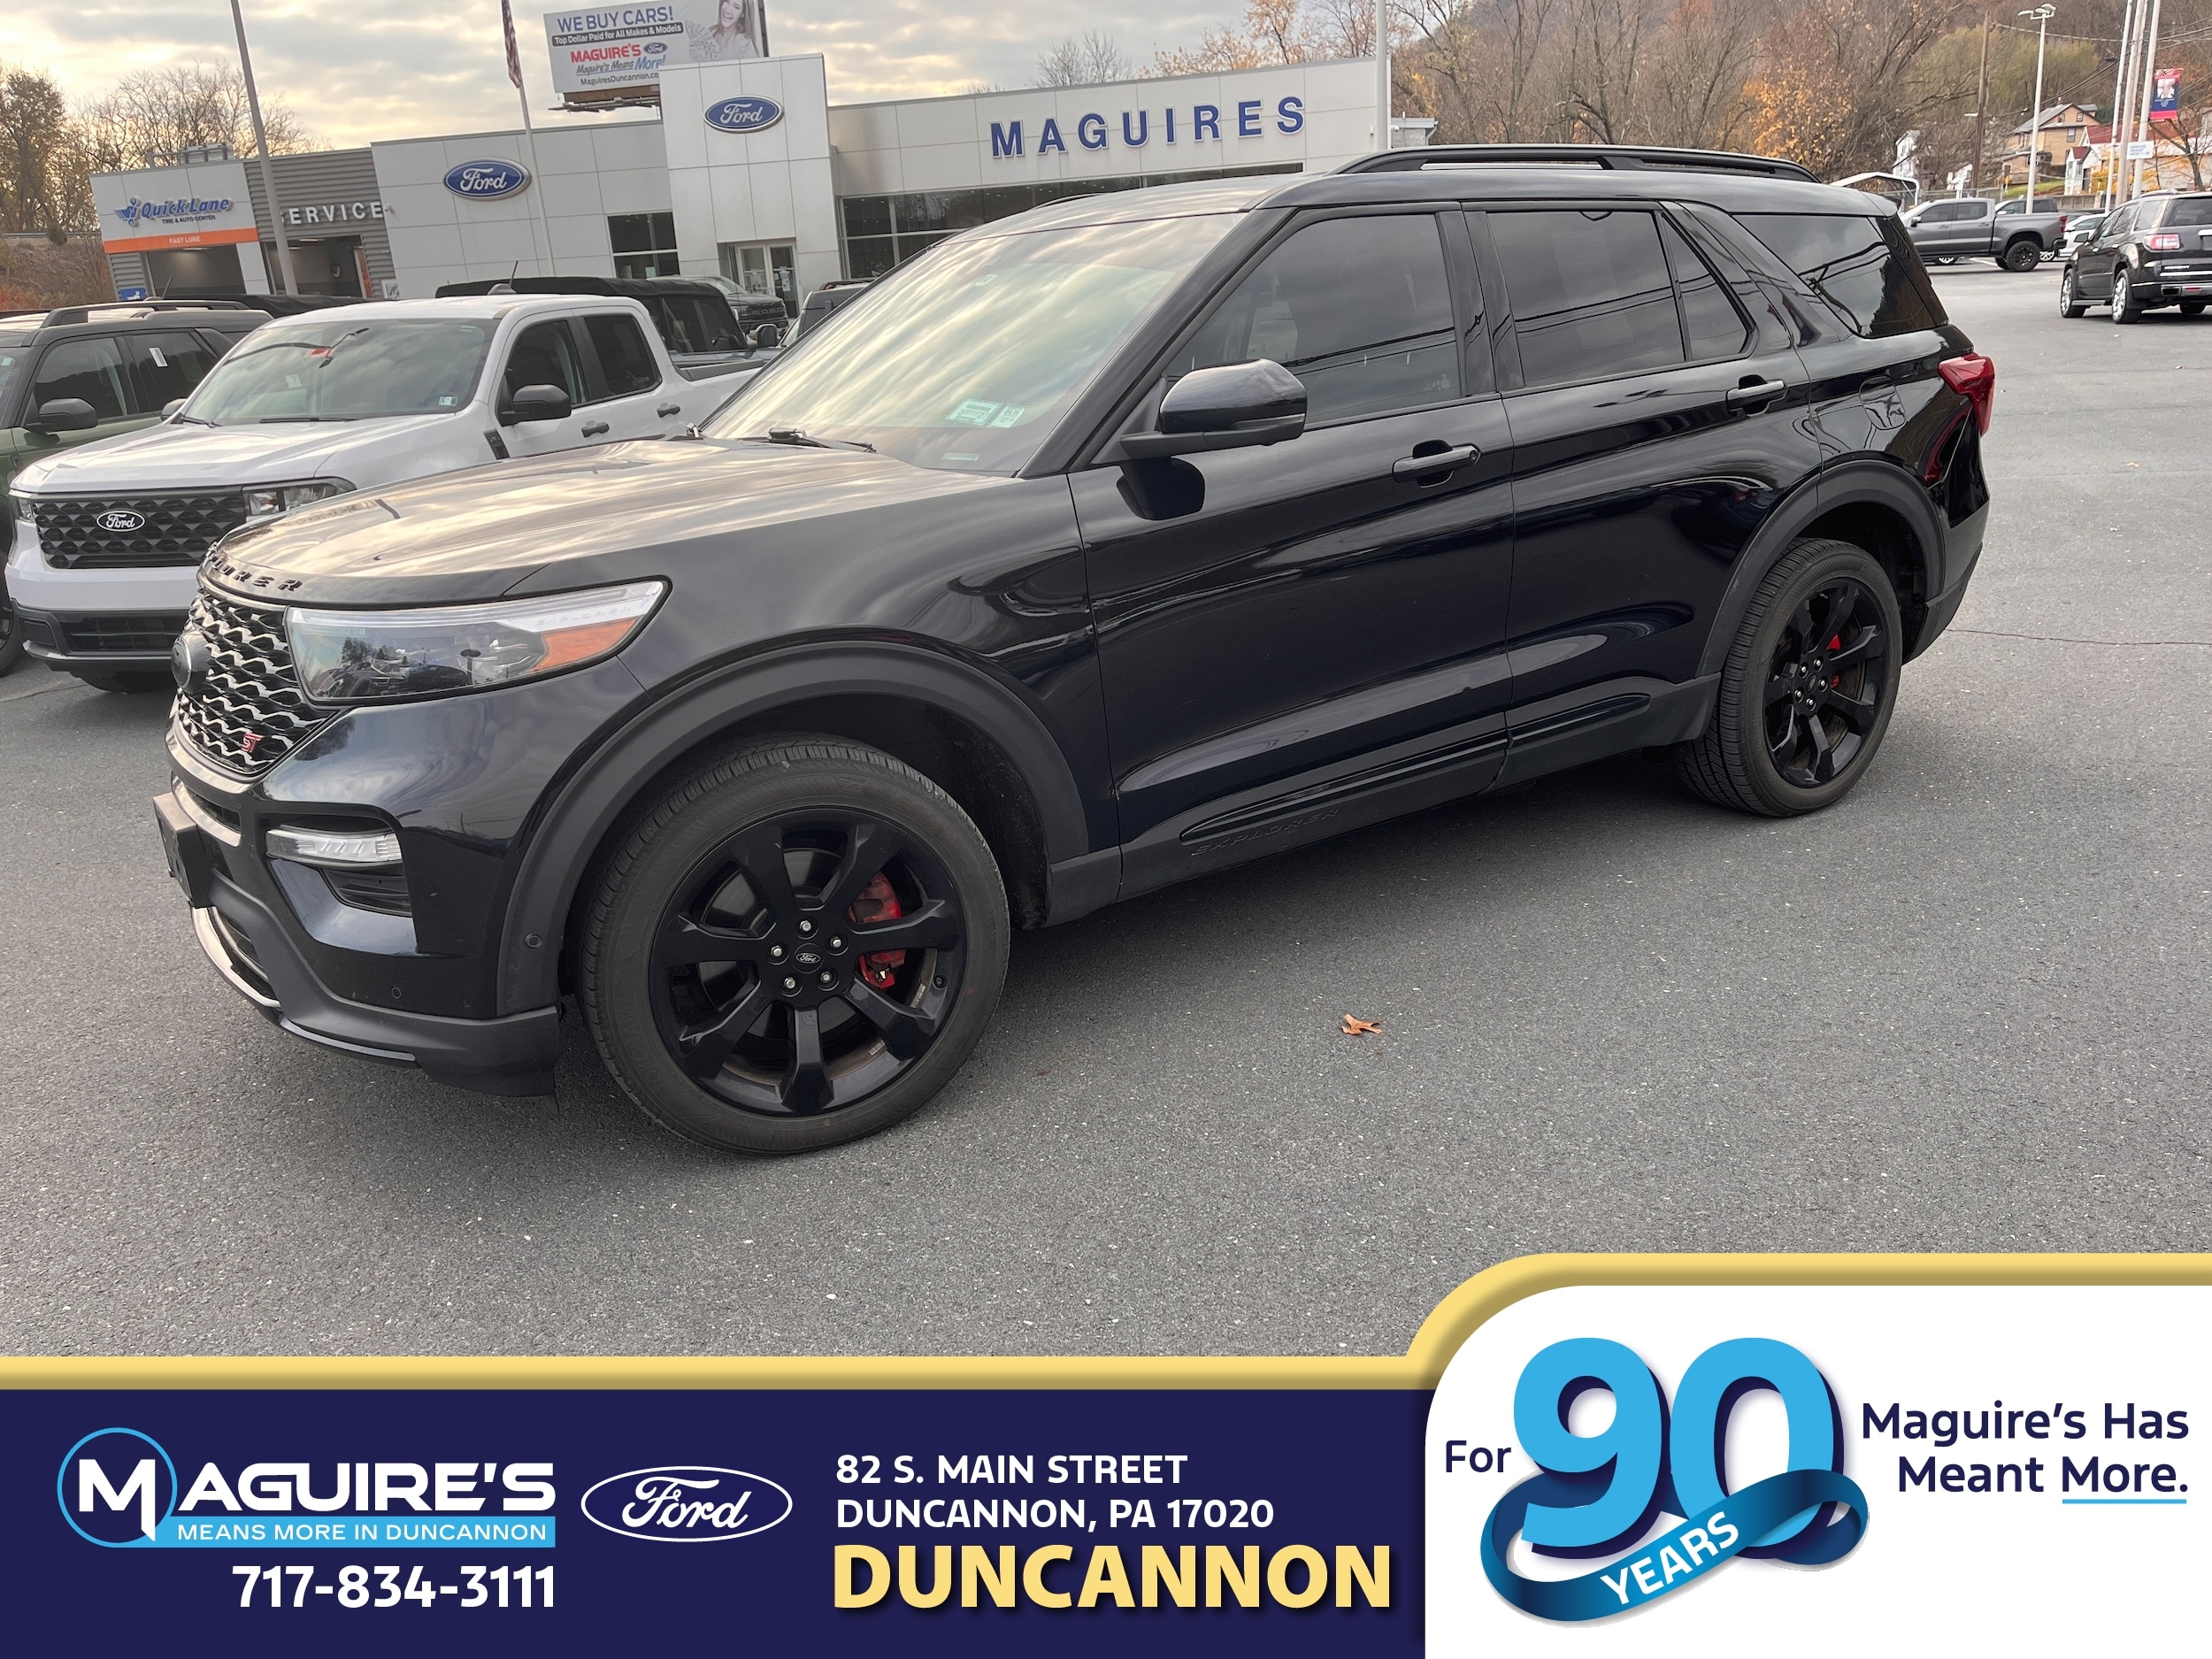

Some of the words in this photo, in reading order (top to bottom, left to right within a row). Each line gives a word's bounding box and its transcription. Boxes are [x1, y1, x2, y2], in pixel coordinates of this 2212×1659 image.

[557, 17, 583, 33] WE
[587, 12, 618, 30] BUY
[623, 6, 673, 25] CARS!
[554, 36, 567, 45] Top
[568, 33, 588, 42] Dollar
[589, 32, 603, 42] Paid
[604, 31, 615, 40] for
[626, 27, 649, 37] Makes
[656, 24, 681, 34] Models
[570, 43, 642, 63] MAGUIRE'S
[577, 63, 610, 75] Maguire's
[611, 60, 634, 70] Means
[634, 55, 666, 71] More!
[580, 72, 659, 86] MaguiresDuncannon.co
[719, 103, 764, 124] Ford
[990, 96, 1305, 158] MAGUIRES
[459, 167, 507, 192] Ford
[142, 199, 186, 219] Quick
[189, 198, 229, 212] Lane
[106, 513, 135, 528] Ford
[241, 732, 265, 753] ST
[1191, 809, 1340, 856] EXPLORER
